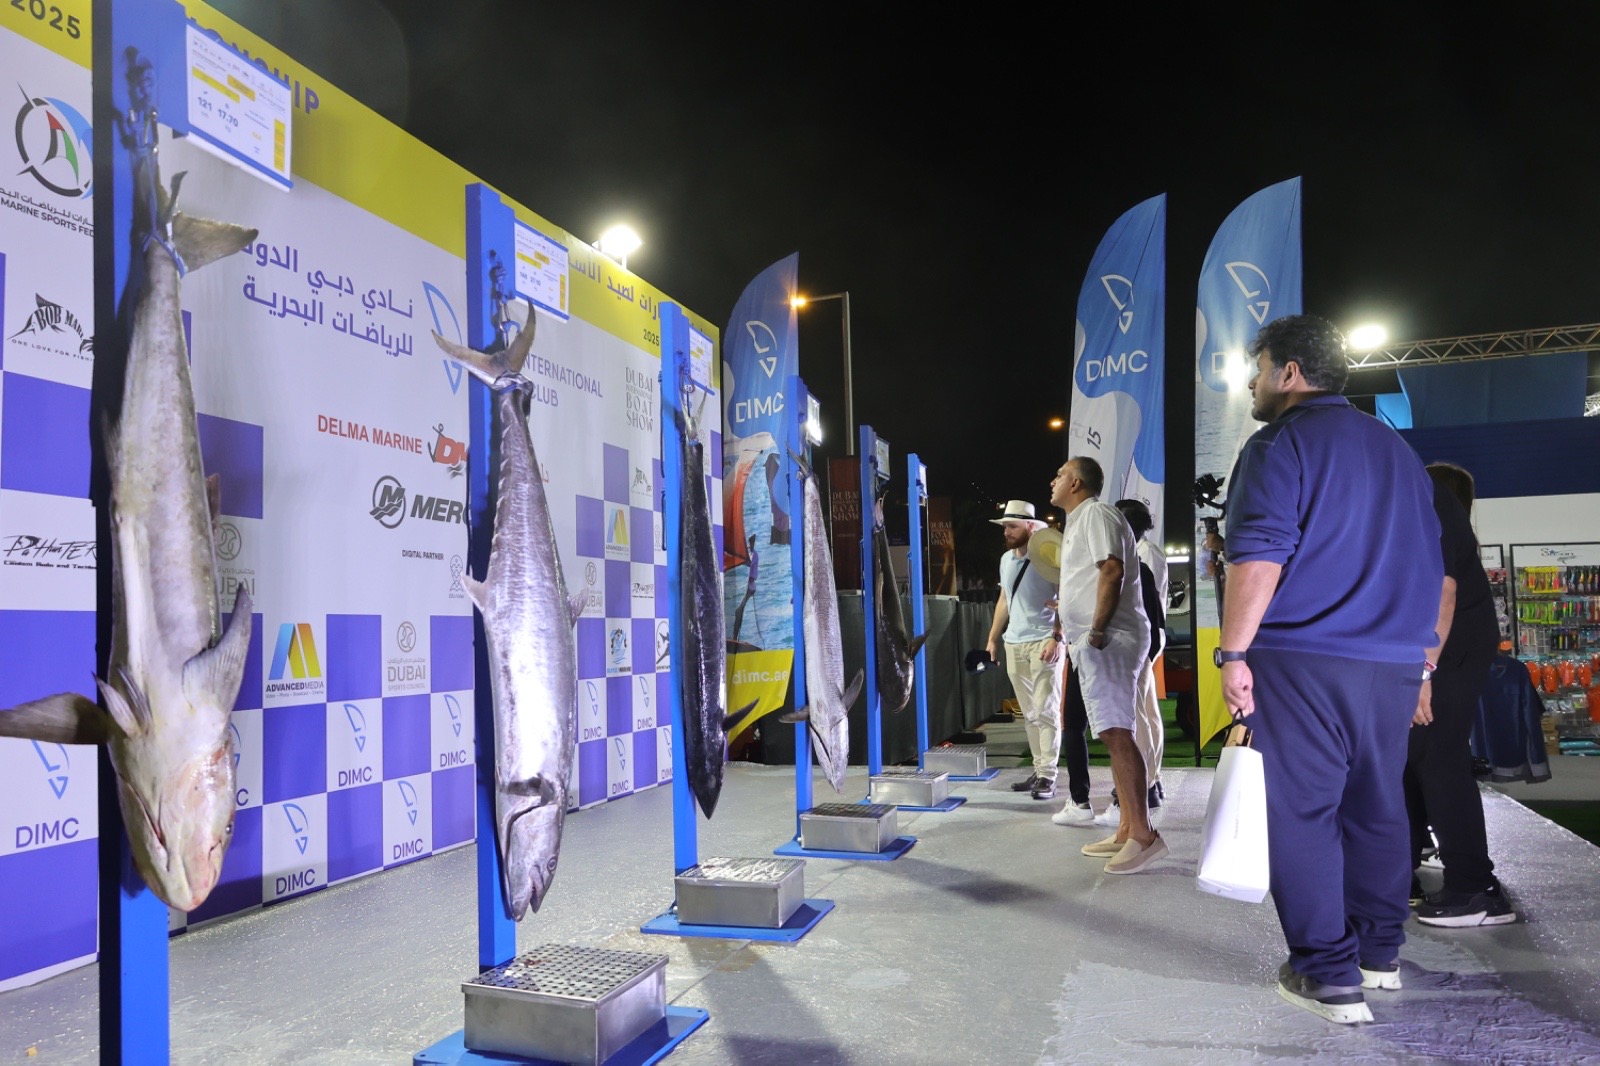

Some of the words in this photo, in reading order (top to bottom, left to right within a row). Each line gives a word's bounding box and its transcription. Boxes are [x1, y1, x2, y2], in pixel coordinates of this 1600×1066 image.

[1, 198, 39, 218] MARINE
[41, 212, 77, 231] SPORTS
[78, 226, 94, 237] FED
[307, 270, 354, 297] دبي
[243, 275, 323, 326] البحرية
[362, 289, 413, 319] نادي
[34, 306, 62, 331] BOB
[332, 311, 413, 357] للرياضات
[643, 328, 660, 347] 2025
[11, 339, 28, 347] ONE
[31, 344, 51, 352] LOVE
[73, 354, 93, 362] FISHI
[523, 352, 603, 398] NTERNATIONAL
[1086, 350, 1148, 382] DIMC
[625, 366, 653, 392] DUBAI
[625, 392, 653, 415] BOAT
[735, 392, 784, 423] DIMC
[625, 410, 653, 433] SHOW
[318, 414, 369, 442] DELMA
[372, 427, 423, 454] MARINE
[402, 550, 422, 558] DIGITAL
[422, 551, 444, 561] PARTNER
[388, 665, 426, 682] DUBAI
[584, 727, 602, 740] DIMC
[637, 719, 653, 730] DIMC
[440, 750, 467, 767] DIMC
[338, 766, 373, 787] DIMC
[661, 769, 673, 780] DIM
[612, 780, 629, 794] DIMC
[16, 817, 80, 849] DIMC
[393, 838, 424, 860] DIMC
[276, 869, 316, 896] DIMC
